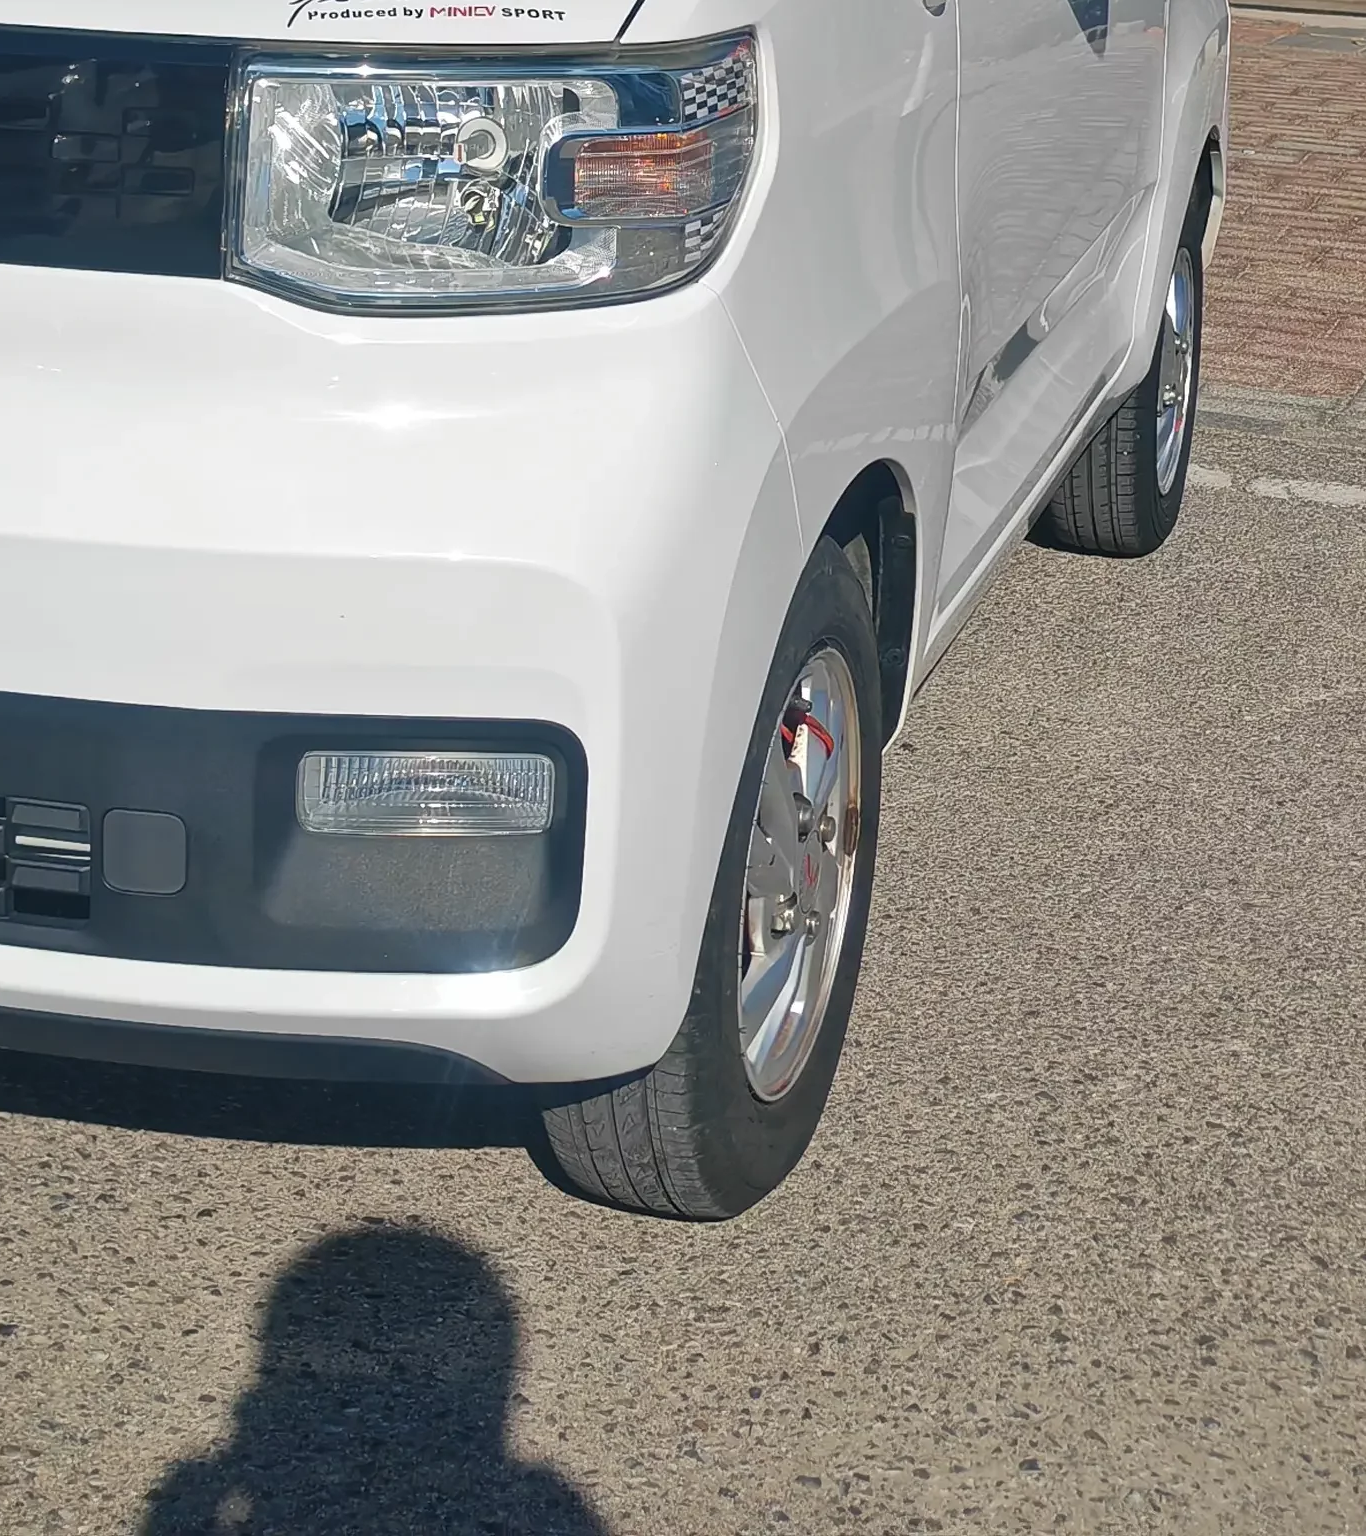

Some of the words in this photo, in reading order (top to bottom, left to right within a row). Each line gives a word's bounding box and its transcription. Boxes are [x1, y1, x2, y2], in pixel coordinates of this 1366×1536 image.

[307, 7, 398, 21] Produced
[403, 6, 425, 20] by
[501, 7, 566, 22] SPORT
